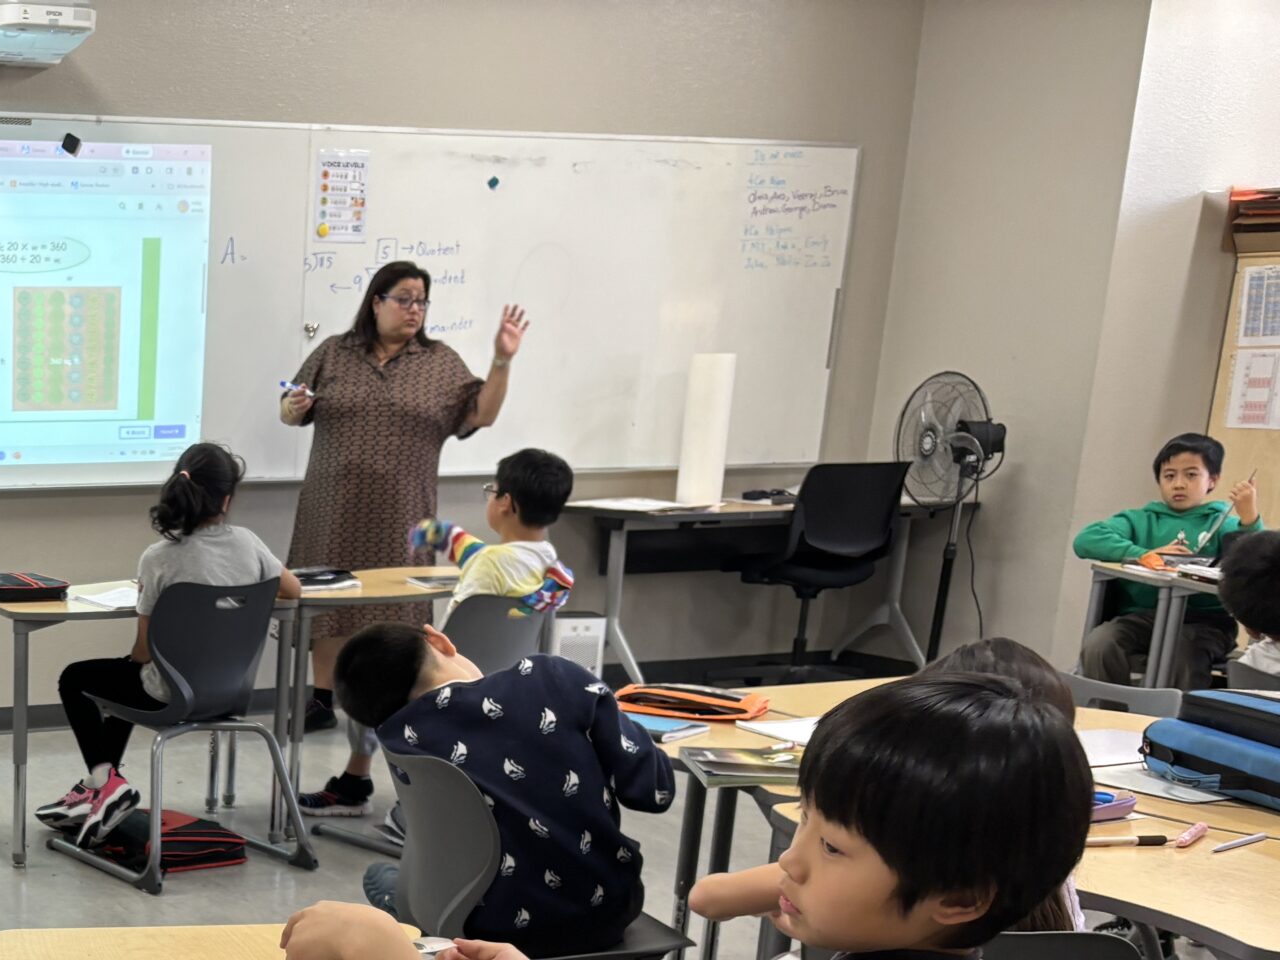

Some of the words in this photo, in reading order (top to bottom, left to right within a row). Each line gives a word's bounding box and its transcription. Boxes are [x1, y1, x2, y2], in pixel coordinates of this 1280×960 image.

[7, 241, 19, 251] 20
[50, 242, 68, 251] 360
[0, 254, 17, 264] 360
[29, 254, 41, 264] 20
